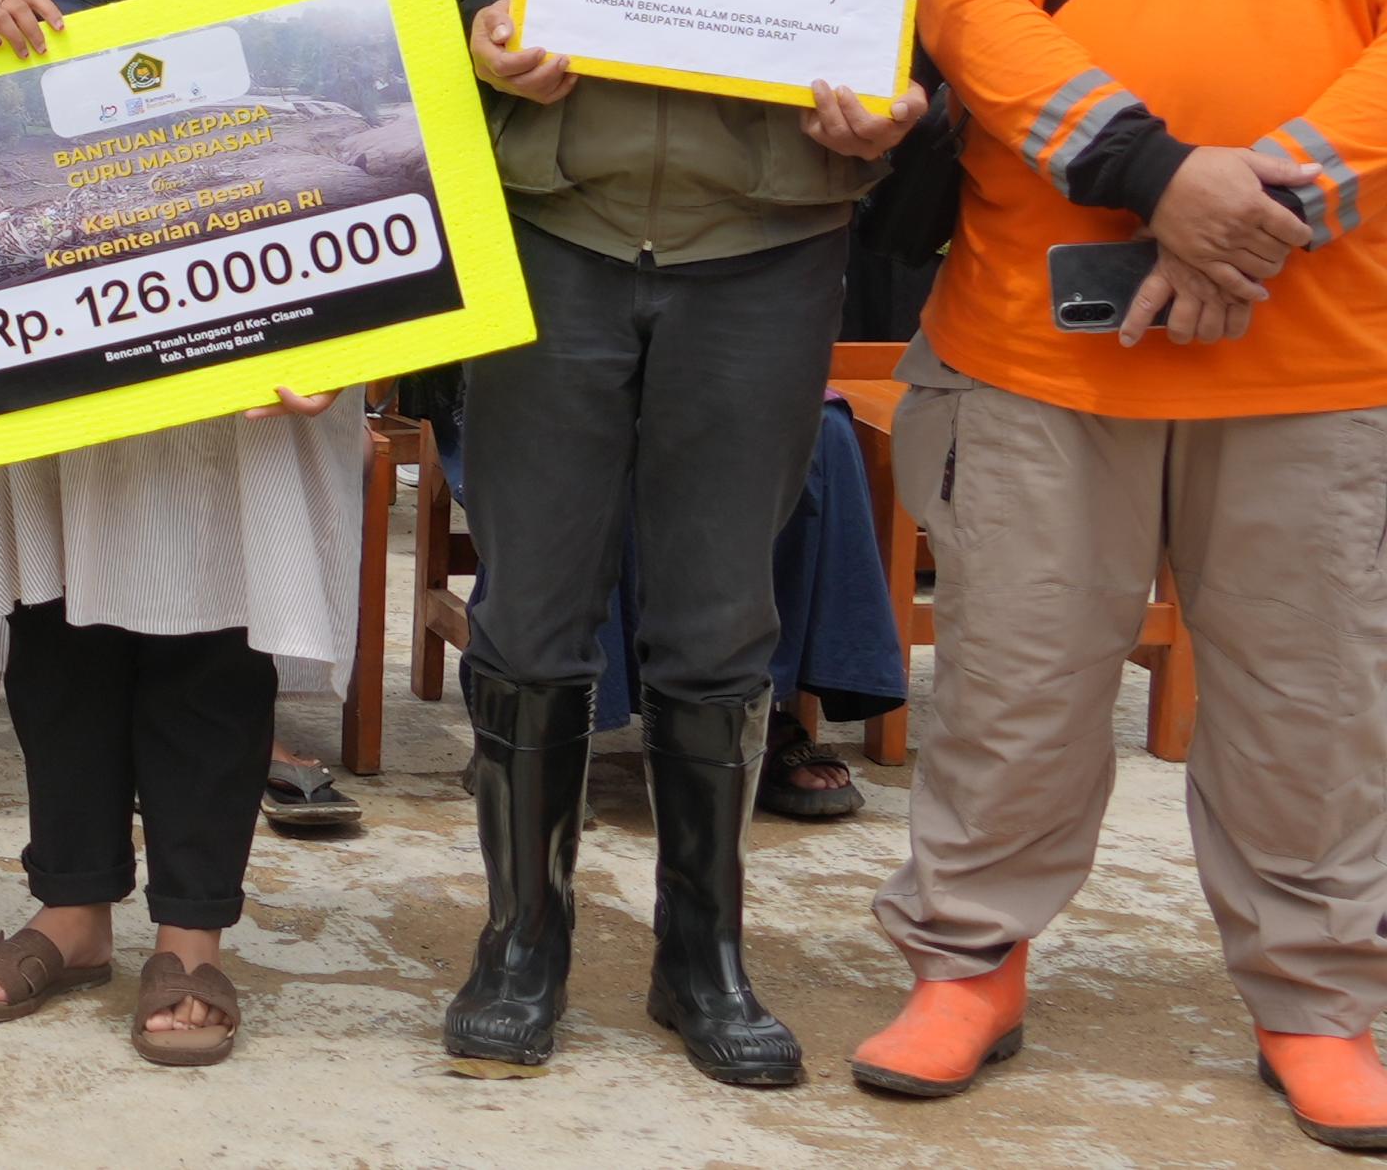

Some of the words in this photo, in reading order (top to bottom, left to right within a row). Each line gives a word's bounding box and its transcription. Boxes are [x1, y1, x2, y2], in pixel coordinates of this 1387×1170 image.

[624, 12, 694, 29] KABUPATEN
[697, 21, 754, 37] BANDUNG
[756, 28, 797, 42] BARAT
[637, 0, 692, 15] BENCANA
[696, 8, 728, 20] ALAM
[731, 13, 762, 25] DESA
[764, 16, 839, 35] PASIRLANGU
[52, 127, 168, 168] BANTUAN
[172, 104, 271, 139] KEPADA
[66, 158, 134, 189] GURU
[138, 126, 274, 172] MADRASAH
[44, 219, 200, 270] Kementerian
[206, 197, 291, 232] Agama
[296, 188, 324, 210] RI
[81, 195, 193, 235] Keluarga
[197, 180, 265, 206] Besar
[75, 213, 418, 330] 126.000.000
[105, 345, 152, 362] Bencana
[153, 336, 187, 351] Tanah
[188, 326, 232, 343] Longsor
[233, 320, 245, 331] di
[246, 316, 270, 330] Kec.
[271, 306, 314, 323] Cisarua
[160, 351, 185, 364] Kab.
[186, 340, 234, 357] Bandung
[235, 332, 264, 346] Barat
